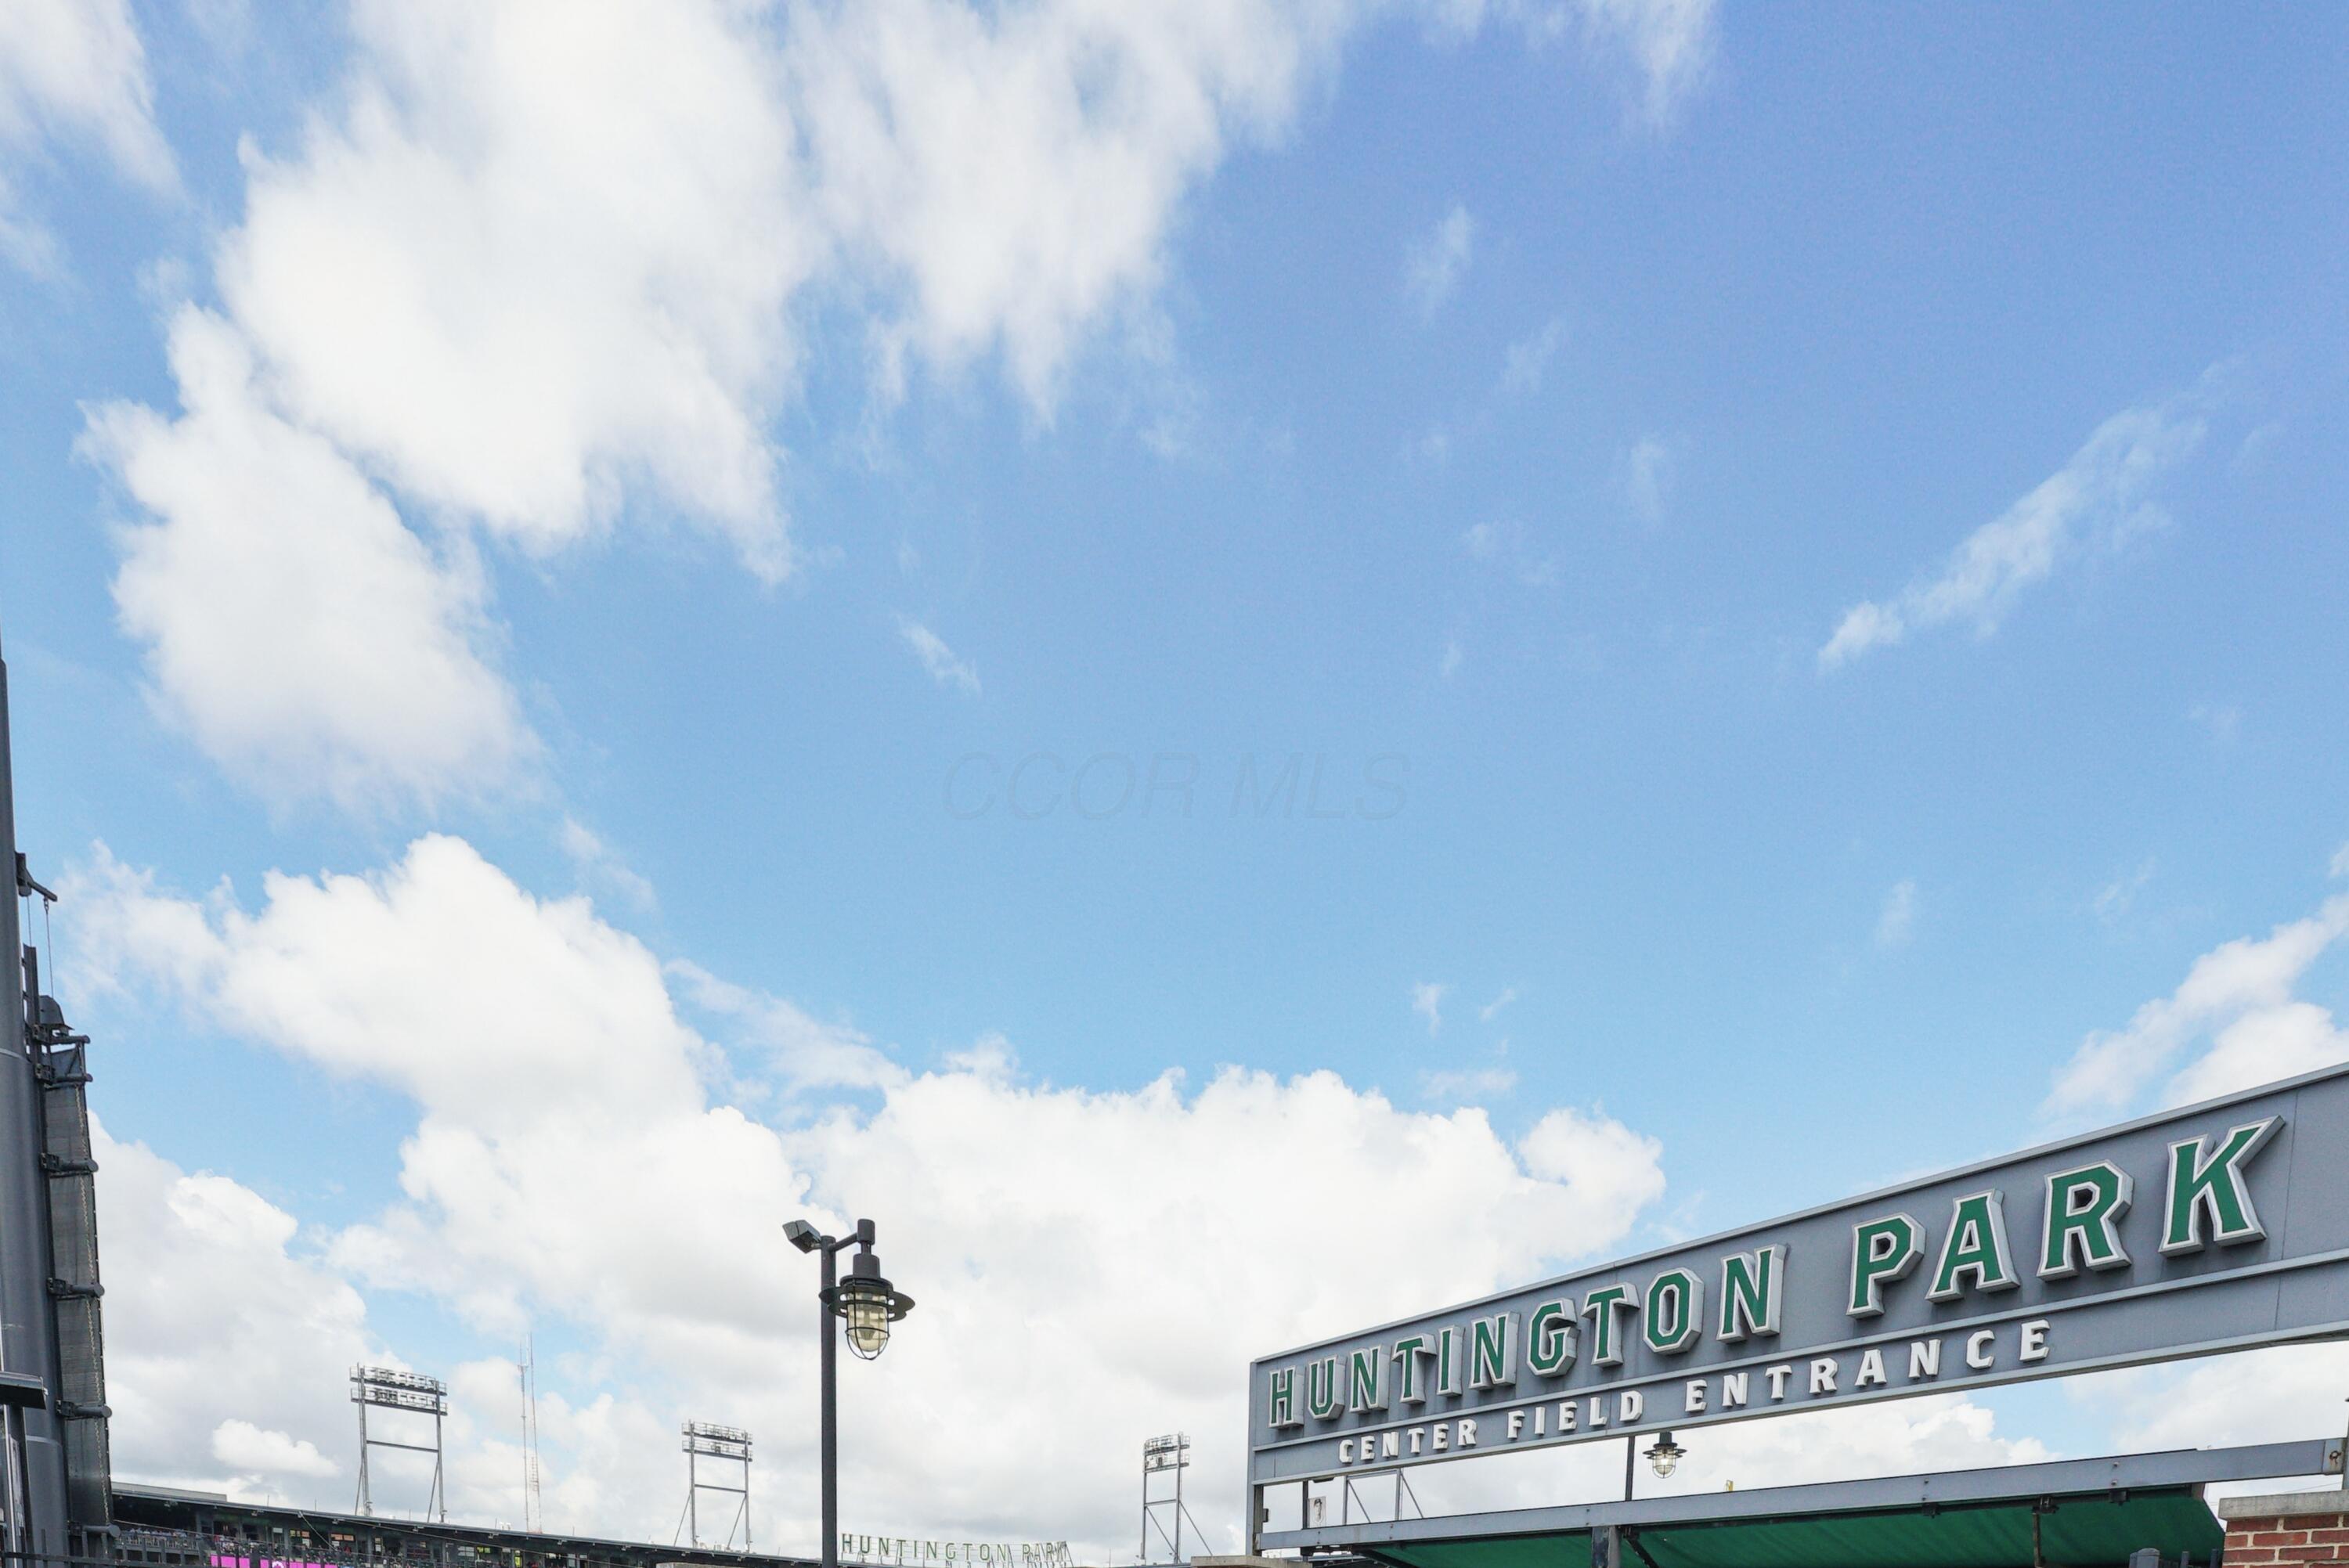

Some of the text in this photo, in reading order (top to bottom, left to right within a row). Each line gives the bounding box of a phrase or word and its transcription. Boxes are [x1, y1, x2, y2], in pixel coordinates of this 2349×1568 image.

[1267, 1116, 2285, 1429] HUNTINGTON PARK
[1338, 1319, 2051, 1464] CENTER FIELD ENTRANCE
[841, 1533, 1068, 1563] HUNTINGTON PARK
